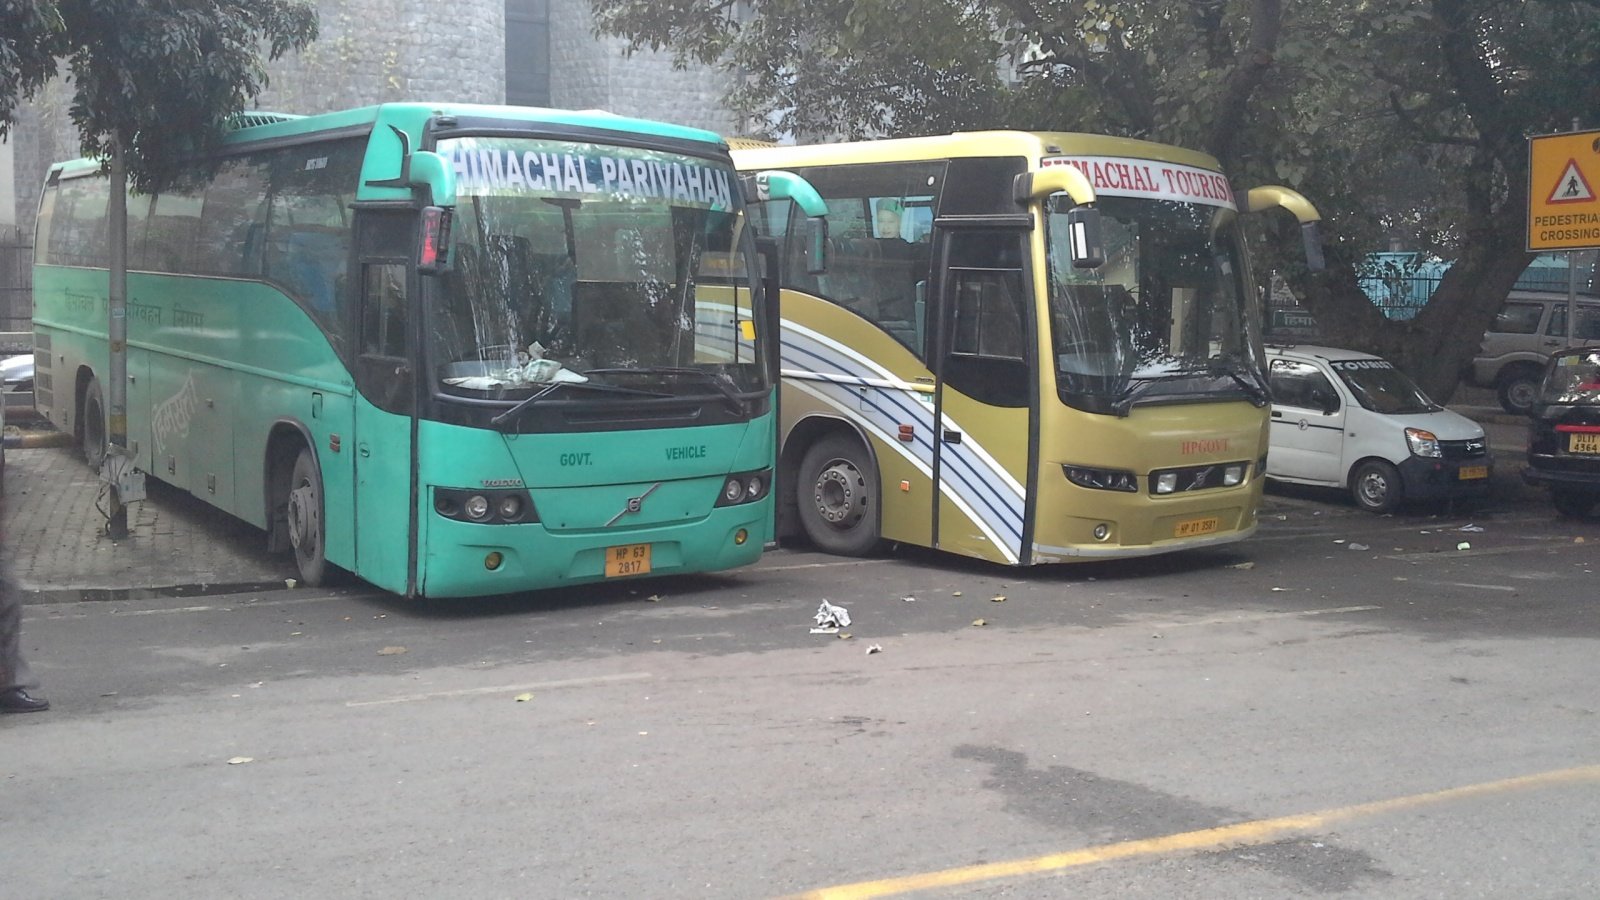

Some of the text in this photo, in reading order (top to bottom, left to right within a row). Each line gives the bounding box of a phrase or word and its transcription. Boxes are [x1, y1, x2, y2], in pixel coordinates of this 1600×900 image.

[447, 149, 733, 212] HIMACHAL PARIVAHAN
[1042, 159, 1160, 192] MACHAL
[1534, 213, 1600, 227] PEDESTRIA
[1540, 228, 1600, 241] CROSSING
[1574, 443, 1597, 452] 4364
[560, 445, 706, 467] GOVT. VEHICLE
[616, 546, 646, 560] HP 63
[618, 560, 641, 574] 2817
